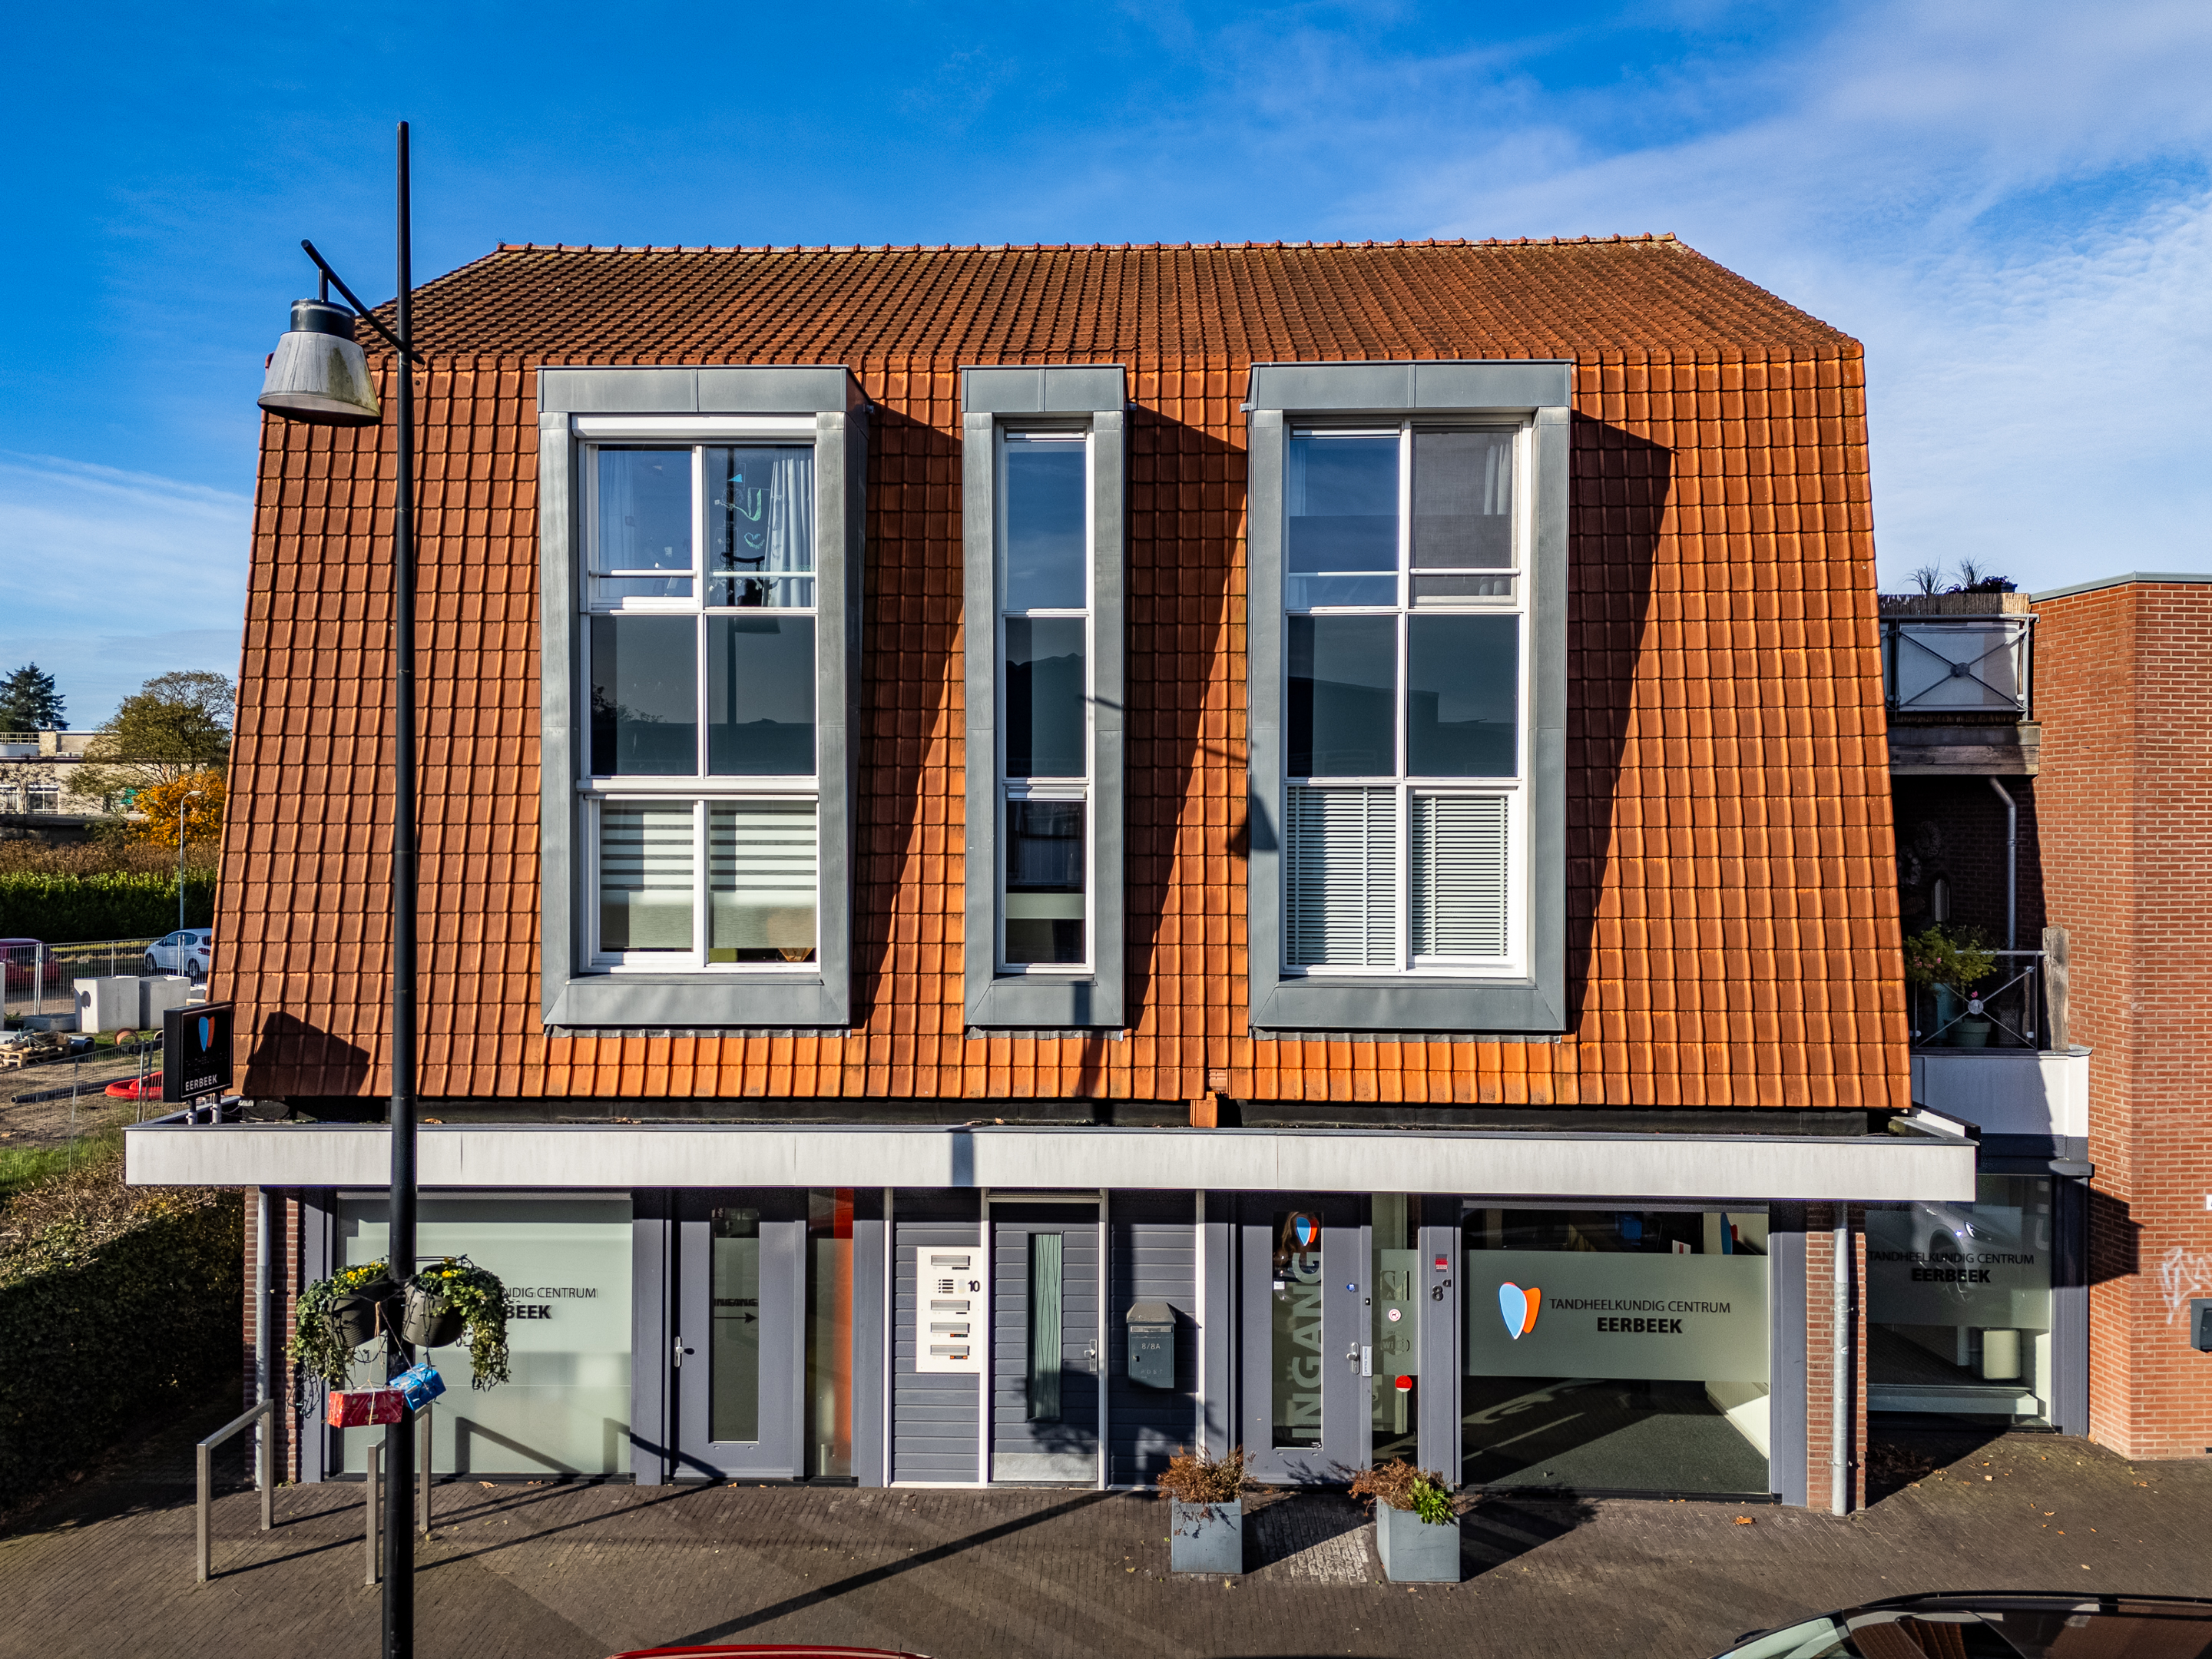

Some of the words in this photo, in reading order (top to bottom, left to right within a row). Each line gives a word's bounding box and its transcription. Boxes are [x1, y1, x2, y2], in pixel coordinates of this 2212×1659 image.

[185, 1074, 218, 1091] EERBEEK
[1868, 1250, 1975, 1263] TANDHEELKUNDIG
[1977, 1253, 2035, 1265] CENTRUM
[1912, 1268, 1991, 1283] EERBEEK
[536, 1286, 598, 1298] CENTRUM
[967, 1280, 981, 1293] 10
[714, 1298, 758, 1306] INGANG
[1548, 1298, 1665, 1312] TANDHEELKUNDIG
[1667, 1300, 1731, 1313] CENTRUM
[506, 1304, 552, 1320] BEEK
[1597, 1316, 1683, 1334] EERBEEK
[1291, 1251, 1322, 1439] INGANG
